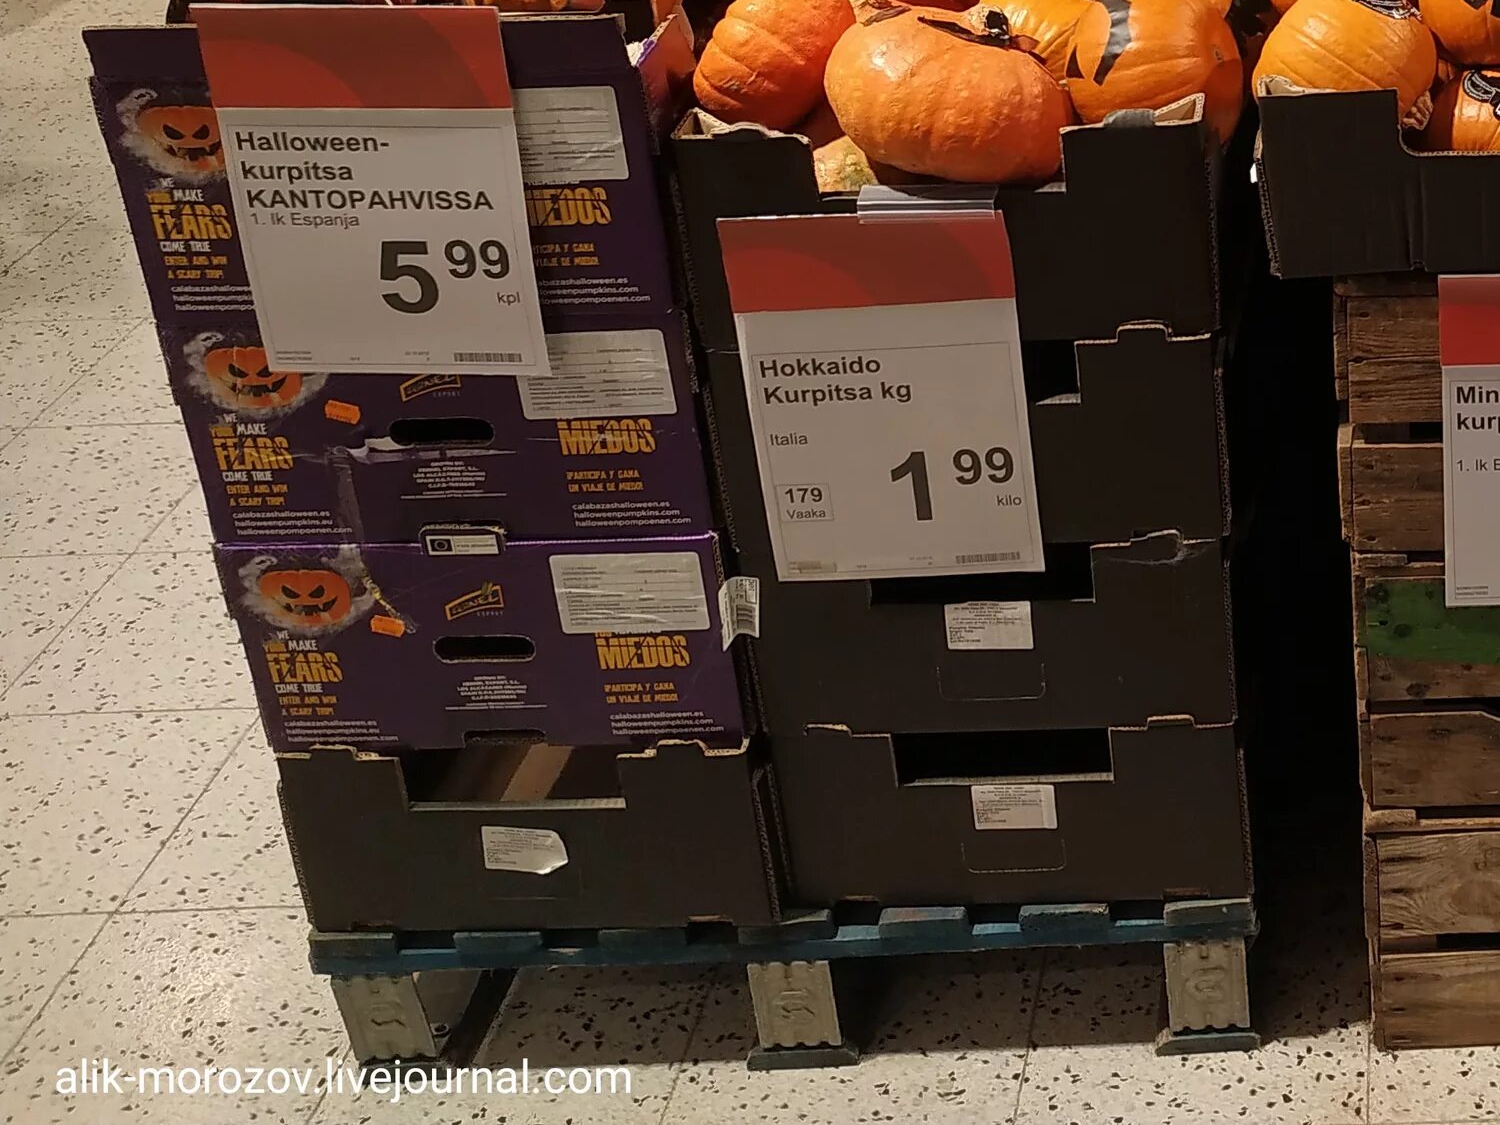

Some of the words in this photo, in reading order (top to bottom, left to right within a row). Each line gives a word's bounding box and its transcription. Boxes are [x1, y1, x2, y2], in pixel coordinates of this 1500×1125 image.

[235, 131, 390, 152] Halloween-
[241, 160, 354, 185] kurpitsa
[246, 189, 495, 211] KANTOPAHVISSA
[149, 203, 233, 240] FEARS
[290, 212, 360, 229] Espanja
[380, 240, 440, 315] 5
[444, 239, 511, 280] 99
[496, 291, 521, 307] kpl
[759, 356, 881, 379] Hokkaido
[763, 384, 873, 407] Kurpitsa
[880, 381, 912, 404] kg
[236, 423, 268, 436] MAKE
[769, 432, 809, 447] Italia
[212, 436, 295, 471] FEARS
[1456, 459, 1470, 473] 1.
[889, 451, 934, 522] 1
[952, 446, 1015, 486] 99
[784, 487, 823, 504] 179
[996, 493, 1022, 507] kilo
[786, 507, 826, 519] Vaaka
[288, 639, 318, 651] MAKE
[596, 635, 691, 670] MIEDOS
[265, 652, 344, 684] FEARS
[275, 684, 300, 694] COME
